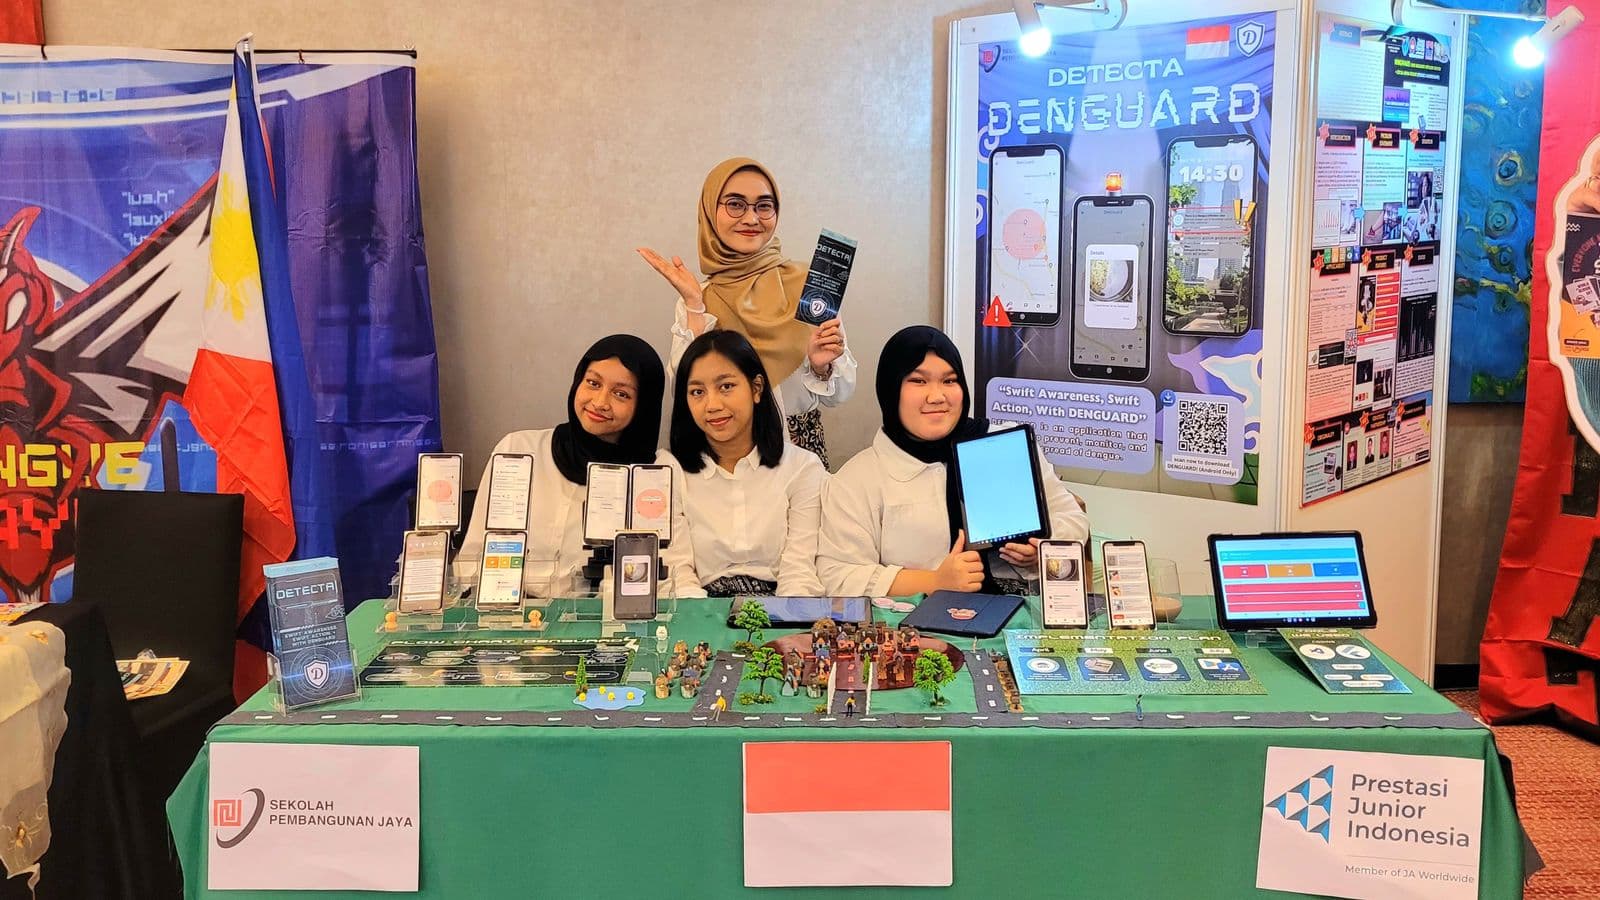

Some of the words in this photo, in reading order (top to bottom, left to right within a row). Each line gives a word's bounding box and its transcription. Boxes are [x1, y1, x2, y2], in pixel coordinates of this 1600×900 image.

[1048, 58, 1184, 87] DETECTA
[988, 82, 1261, 136] DENGUARD
[1179, 164, 1244, 183] 14:30
[816, 244, 850, 260] DETECTA
[1038, 388, 1104, 404] Awareness,
[1107, 394, 1140, 407] Swift
[992, 402, 1032, 416] Action,
[1036, 406, 1065, 418] With
[1040, 422, 1048, 431] is
[1070, 426, 1122, 438] application
[1127, 431, 1148, 441] that
[1085, 450, 1124, 462] dengue.
[1128, 443, 1148, 452] and
[276, 582, 335, 600] DETECTA
[1351, 774, 1448, 798] Prestasi
[270, 800, 334, 811] SEKOLAH
[1348, 797, 1426, 819] Junior
[270, 814, 374, 826] PEMBANGUNAN
[378, 816, 413, 828] JAYA
[1348, 820, 1470, 848] Indonesia
[1345, 865, 1388, 877] Member
[1391, 868, 1401, 877] of
[1402, 869, 1416, 878] JA
[1418, 870, 1474, 884] Worldwide
